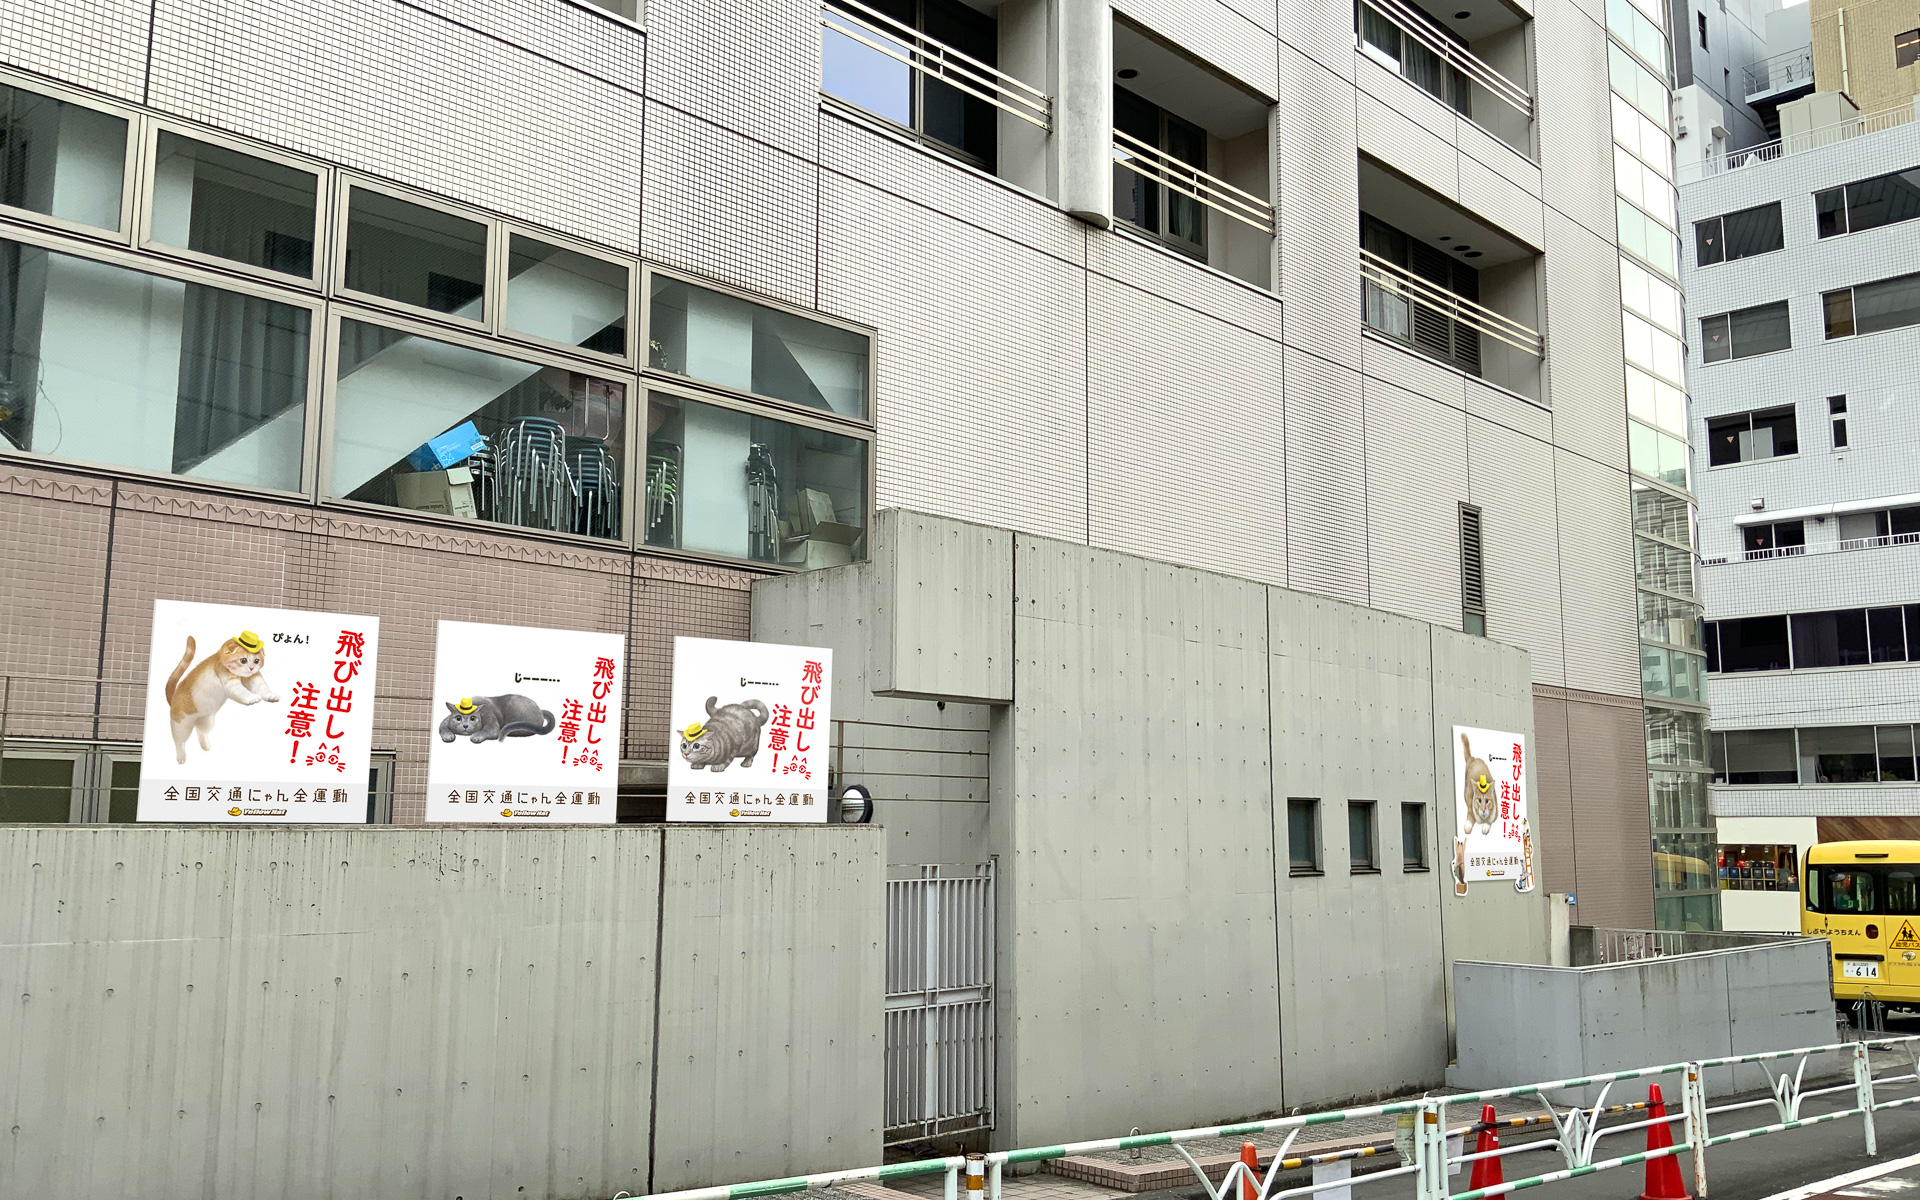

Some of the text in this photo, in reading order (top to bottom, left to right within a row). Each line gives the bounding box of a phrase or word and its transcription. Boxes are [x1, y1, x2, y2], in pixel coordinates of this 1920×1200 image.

[272, 632, 310, 644] ぴょん！
[325, 629, 365, 739] 飛び出し
[587, 656, 616, 744] 飛び出し
[797, 660, 823, 752] 飛び出し
[285, 681, 321, 764] 注意！
[558, 698, 584, 765] 注意！
[768, 703, 793, 773] 注意！
[163, 785, 348, 803] 全国交通にゃん全運動
[447, 789, 600, 805] 全国交通にゃん全運動
[684, 791, 814, 805] 全国交通にゃん全運動
[1500, 780, 1510, 838] 注意！
[1512, 743, 1522, 820] 飛び出し
